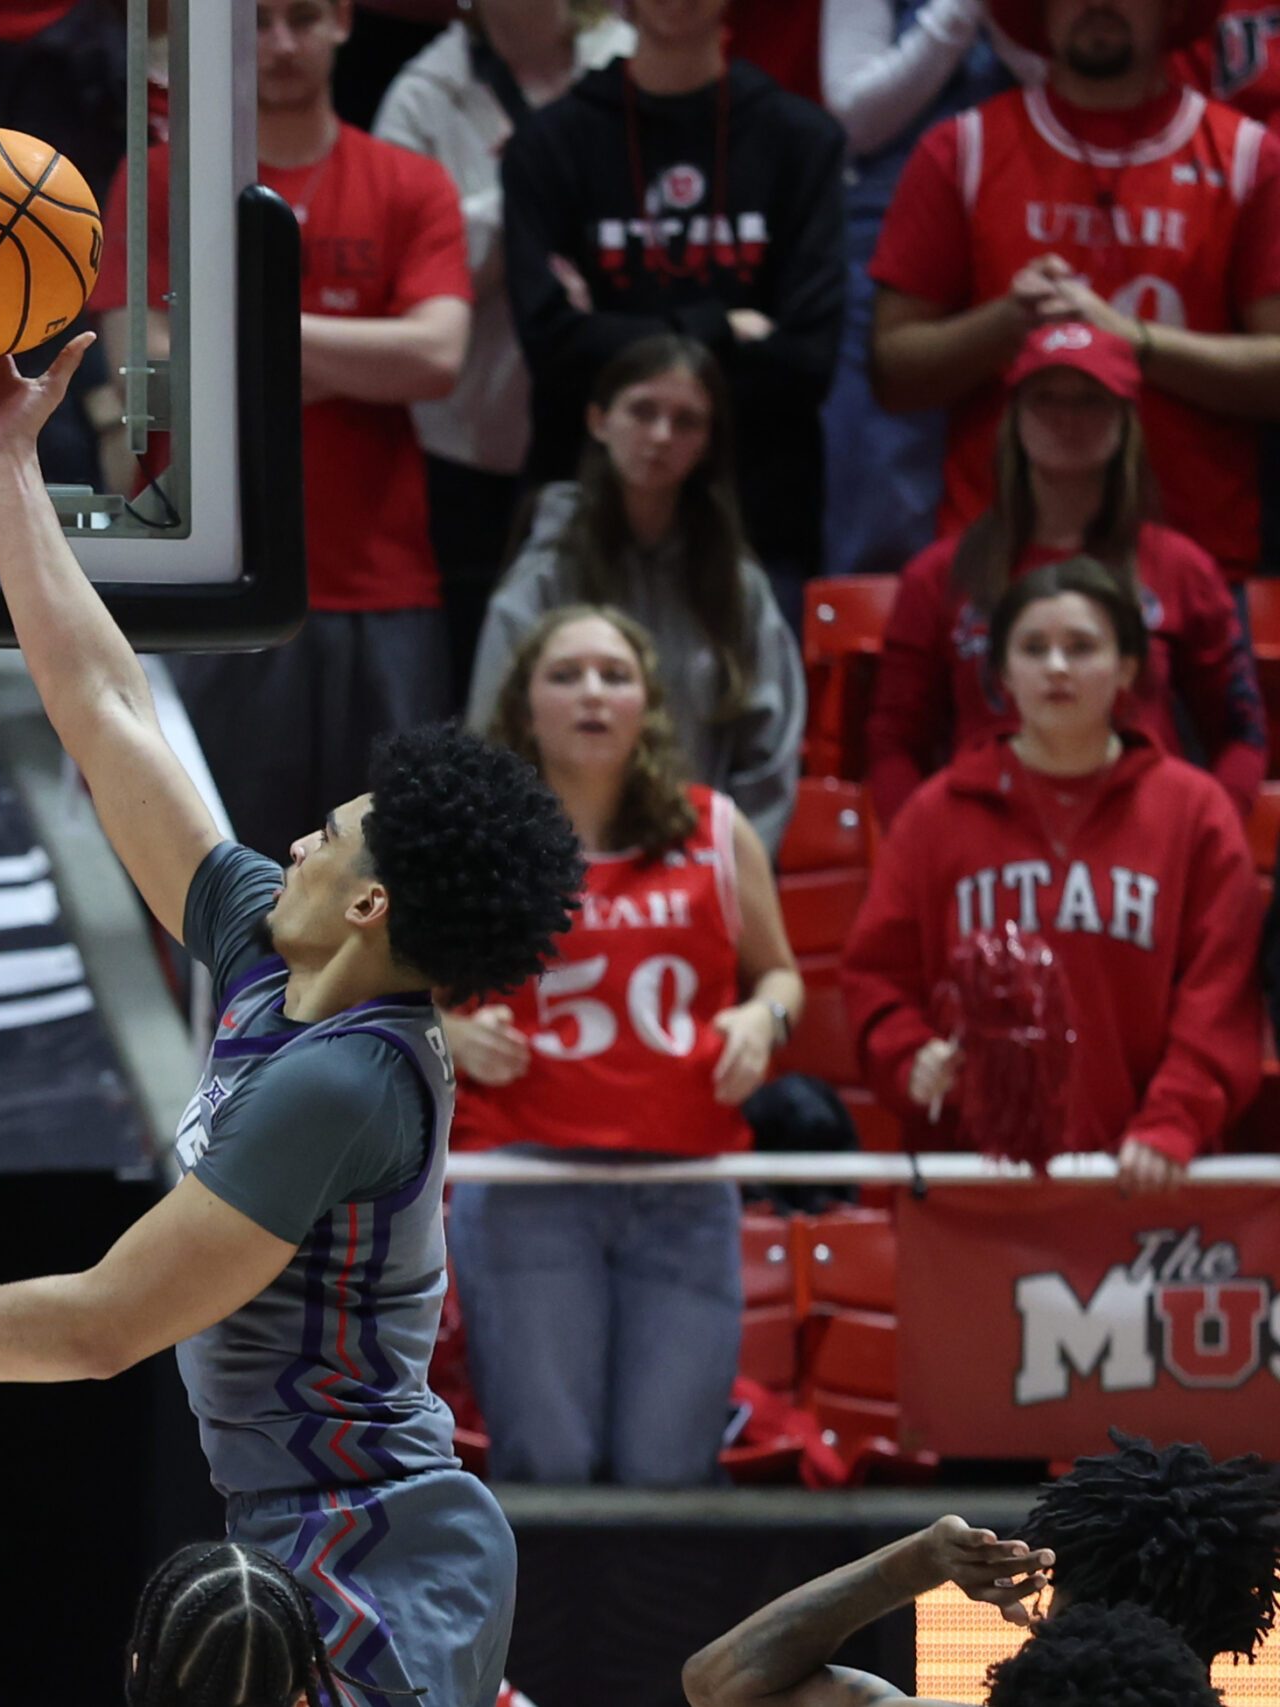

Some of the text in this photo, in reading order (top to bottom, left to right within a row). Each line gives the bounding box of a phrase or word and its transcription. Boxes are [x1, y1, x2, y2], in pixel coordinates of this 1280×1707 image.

[1026, 202, 1185, 251] UTAH
[568, 889, 691, 930] TAH
[956, 859, 1160, 950] UTAH
[531, 953, 698, 1060] 50
[1014, 1263, 1280, 1405] MU
